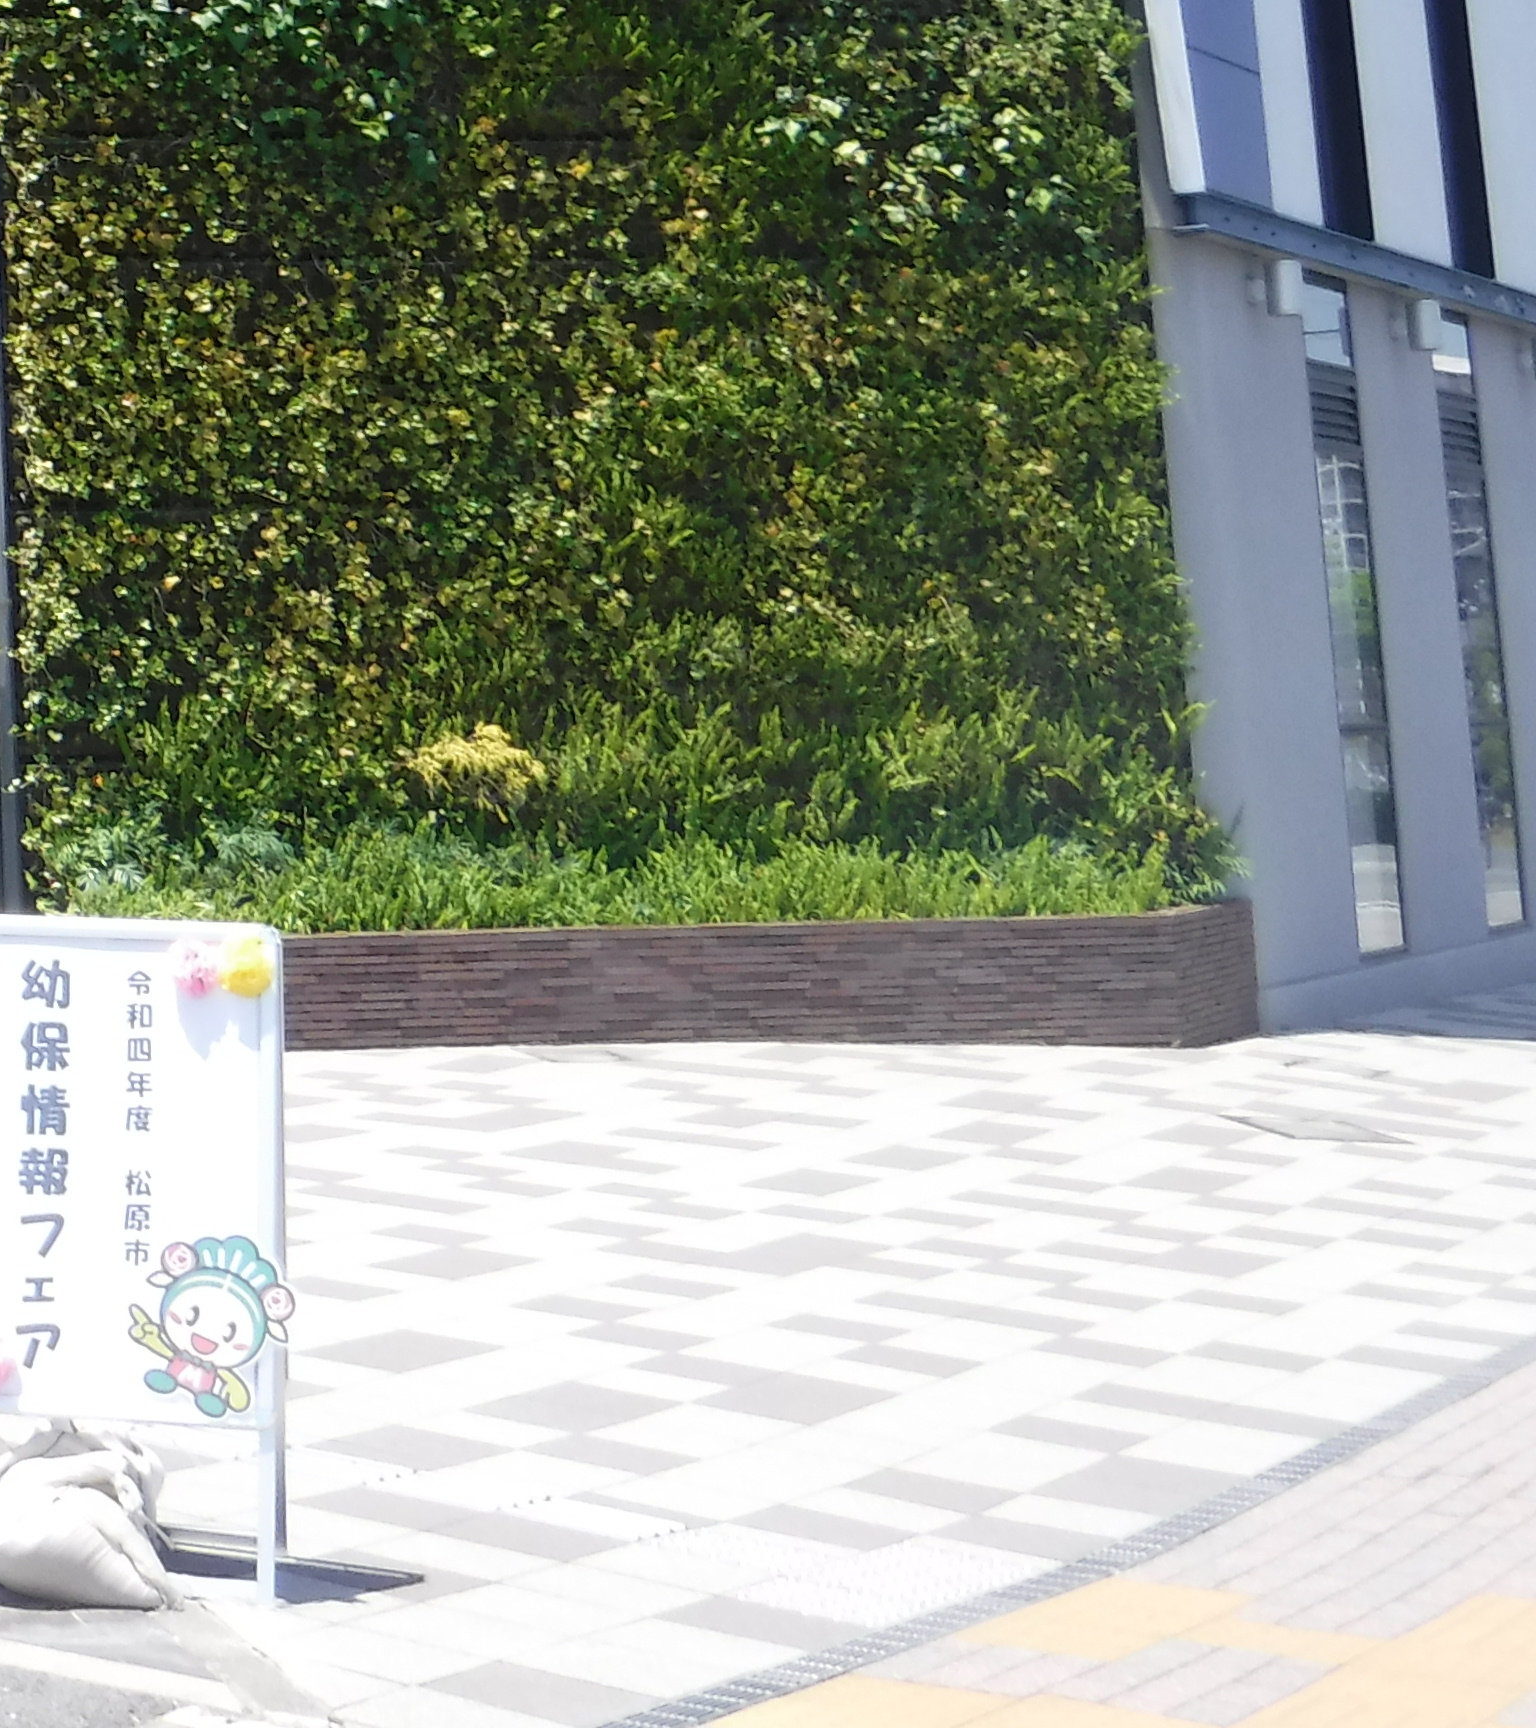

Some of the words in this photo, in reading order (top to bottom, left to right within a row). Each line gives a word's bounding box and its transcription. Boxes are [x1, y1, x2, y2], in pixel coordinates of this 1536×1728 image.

[125, 970, 153, 1132] 令和四年度
[16, 959, 71, 1369] 幼保情報フェア
[124, 1169, 152, 1266] 松原市
